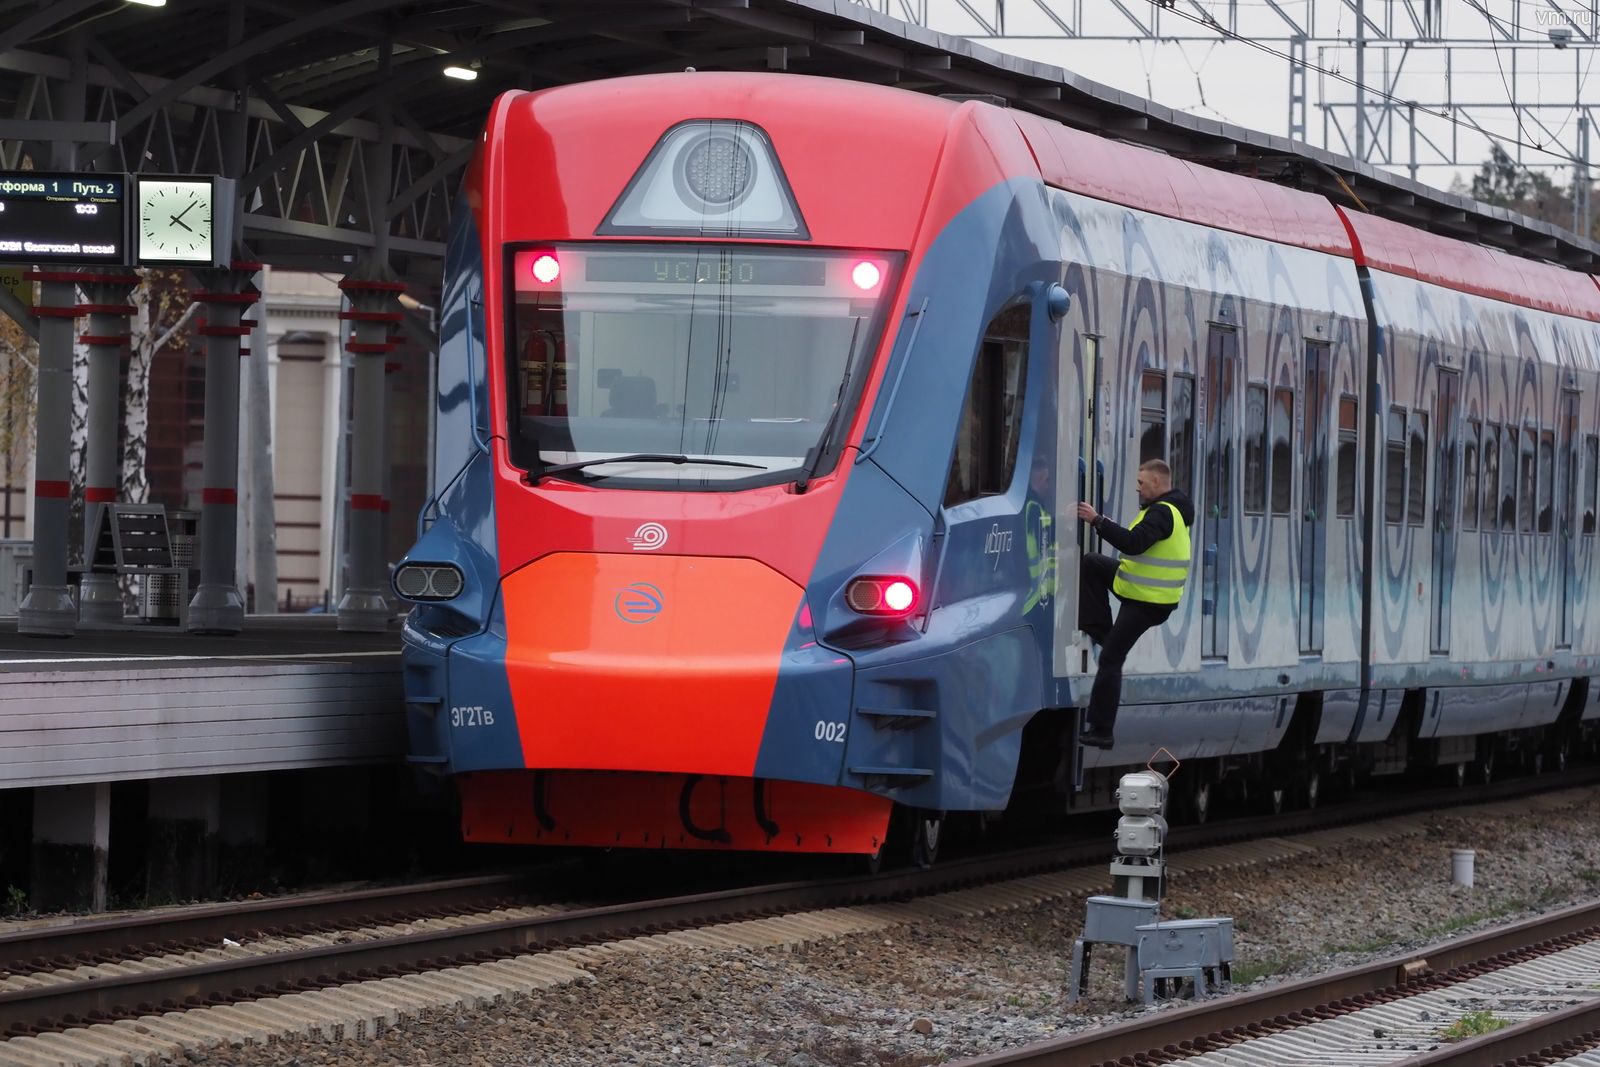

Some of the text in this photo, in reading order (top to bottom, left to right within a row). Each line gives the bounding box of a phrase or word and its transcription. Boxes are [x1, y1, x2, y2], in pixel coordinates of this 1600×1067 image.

[52, 181, 59, 193] 1
[73, 182, 103, 196] Путь
[106, 183, 114, 194] 2
[654, 260, 753, 283] УСОВО
[814, 720, 846, 742] 002
